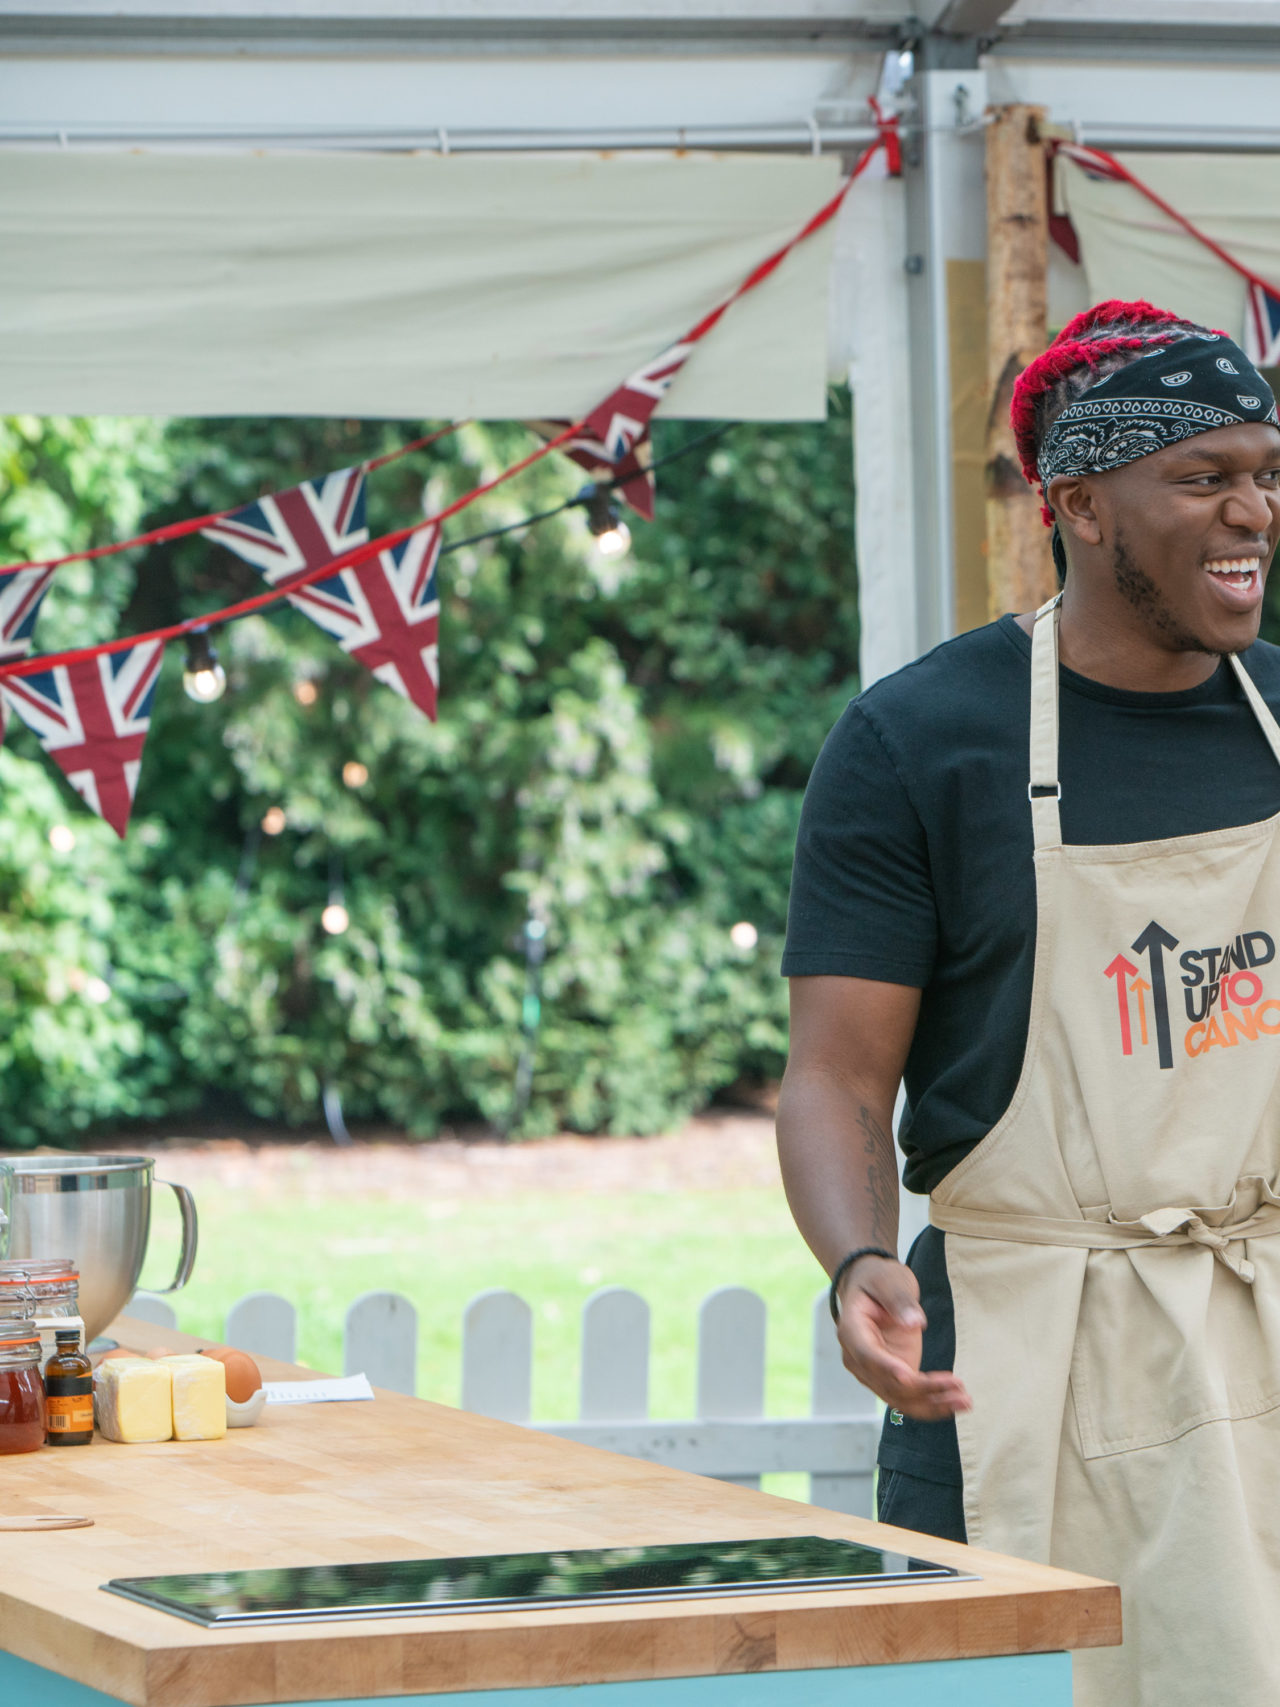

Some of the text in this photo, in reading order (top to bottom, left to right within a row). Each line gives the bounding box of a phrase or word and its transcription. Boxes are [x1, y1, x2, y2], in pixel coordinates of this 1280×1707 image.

[1179, 931, 1276, 987] STAND
[1184, 970, 1264, 1022] UP TO
